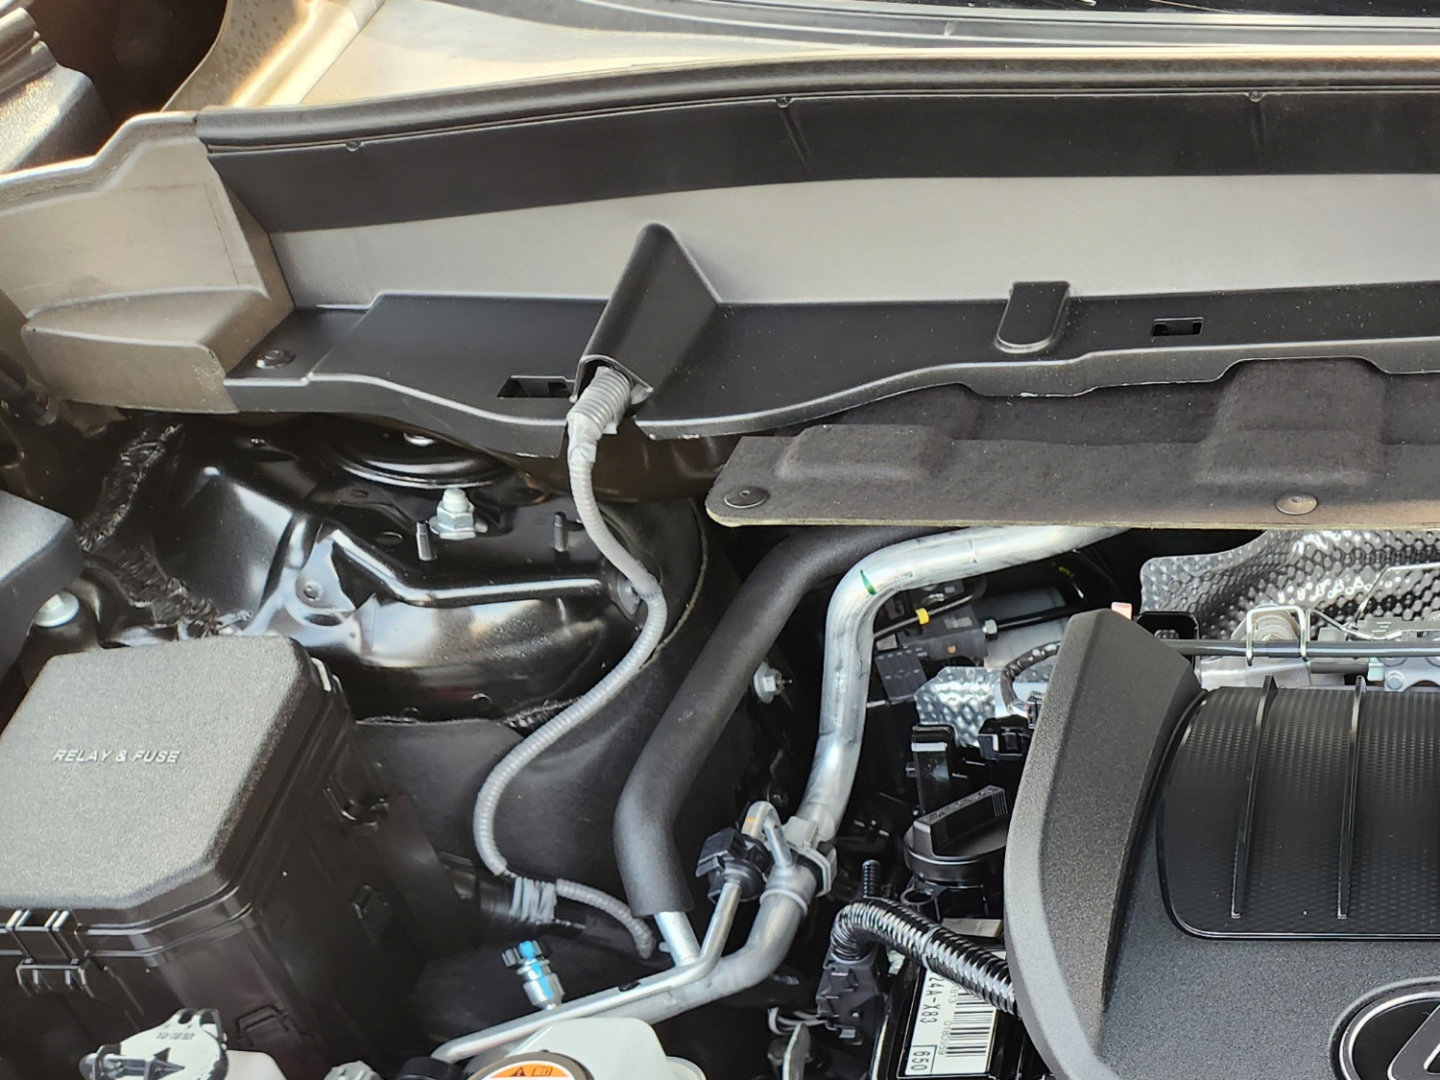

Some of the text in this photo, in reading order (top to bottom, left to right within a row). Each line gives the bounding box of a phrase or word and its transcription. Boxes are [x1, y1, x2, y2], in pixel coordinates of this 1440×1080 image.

[53, 749, 181, 763] RELAY & FUSE
[911, 1050, 931, 1071] 650
